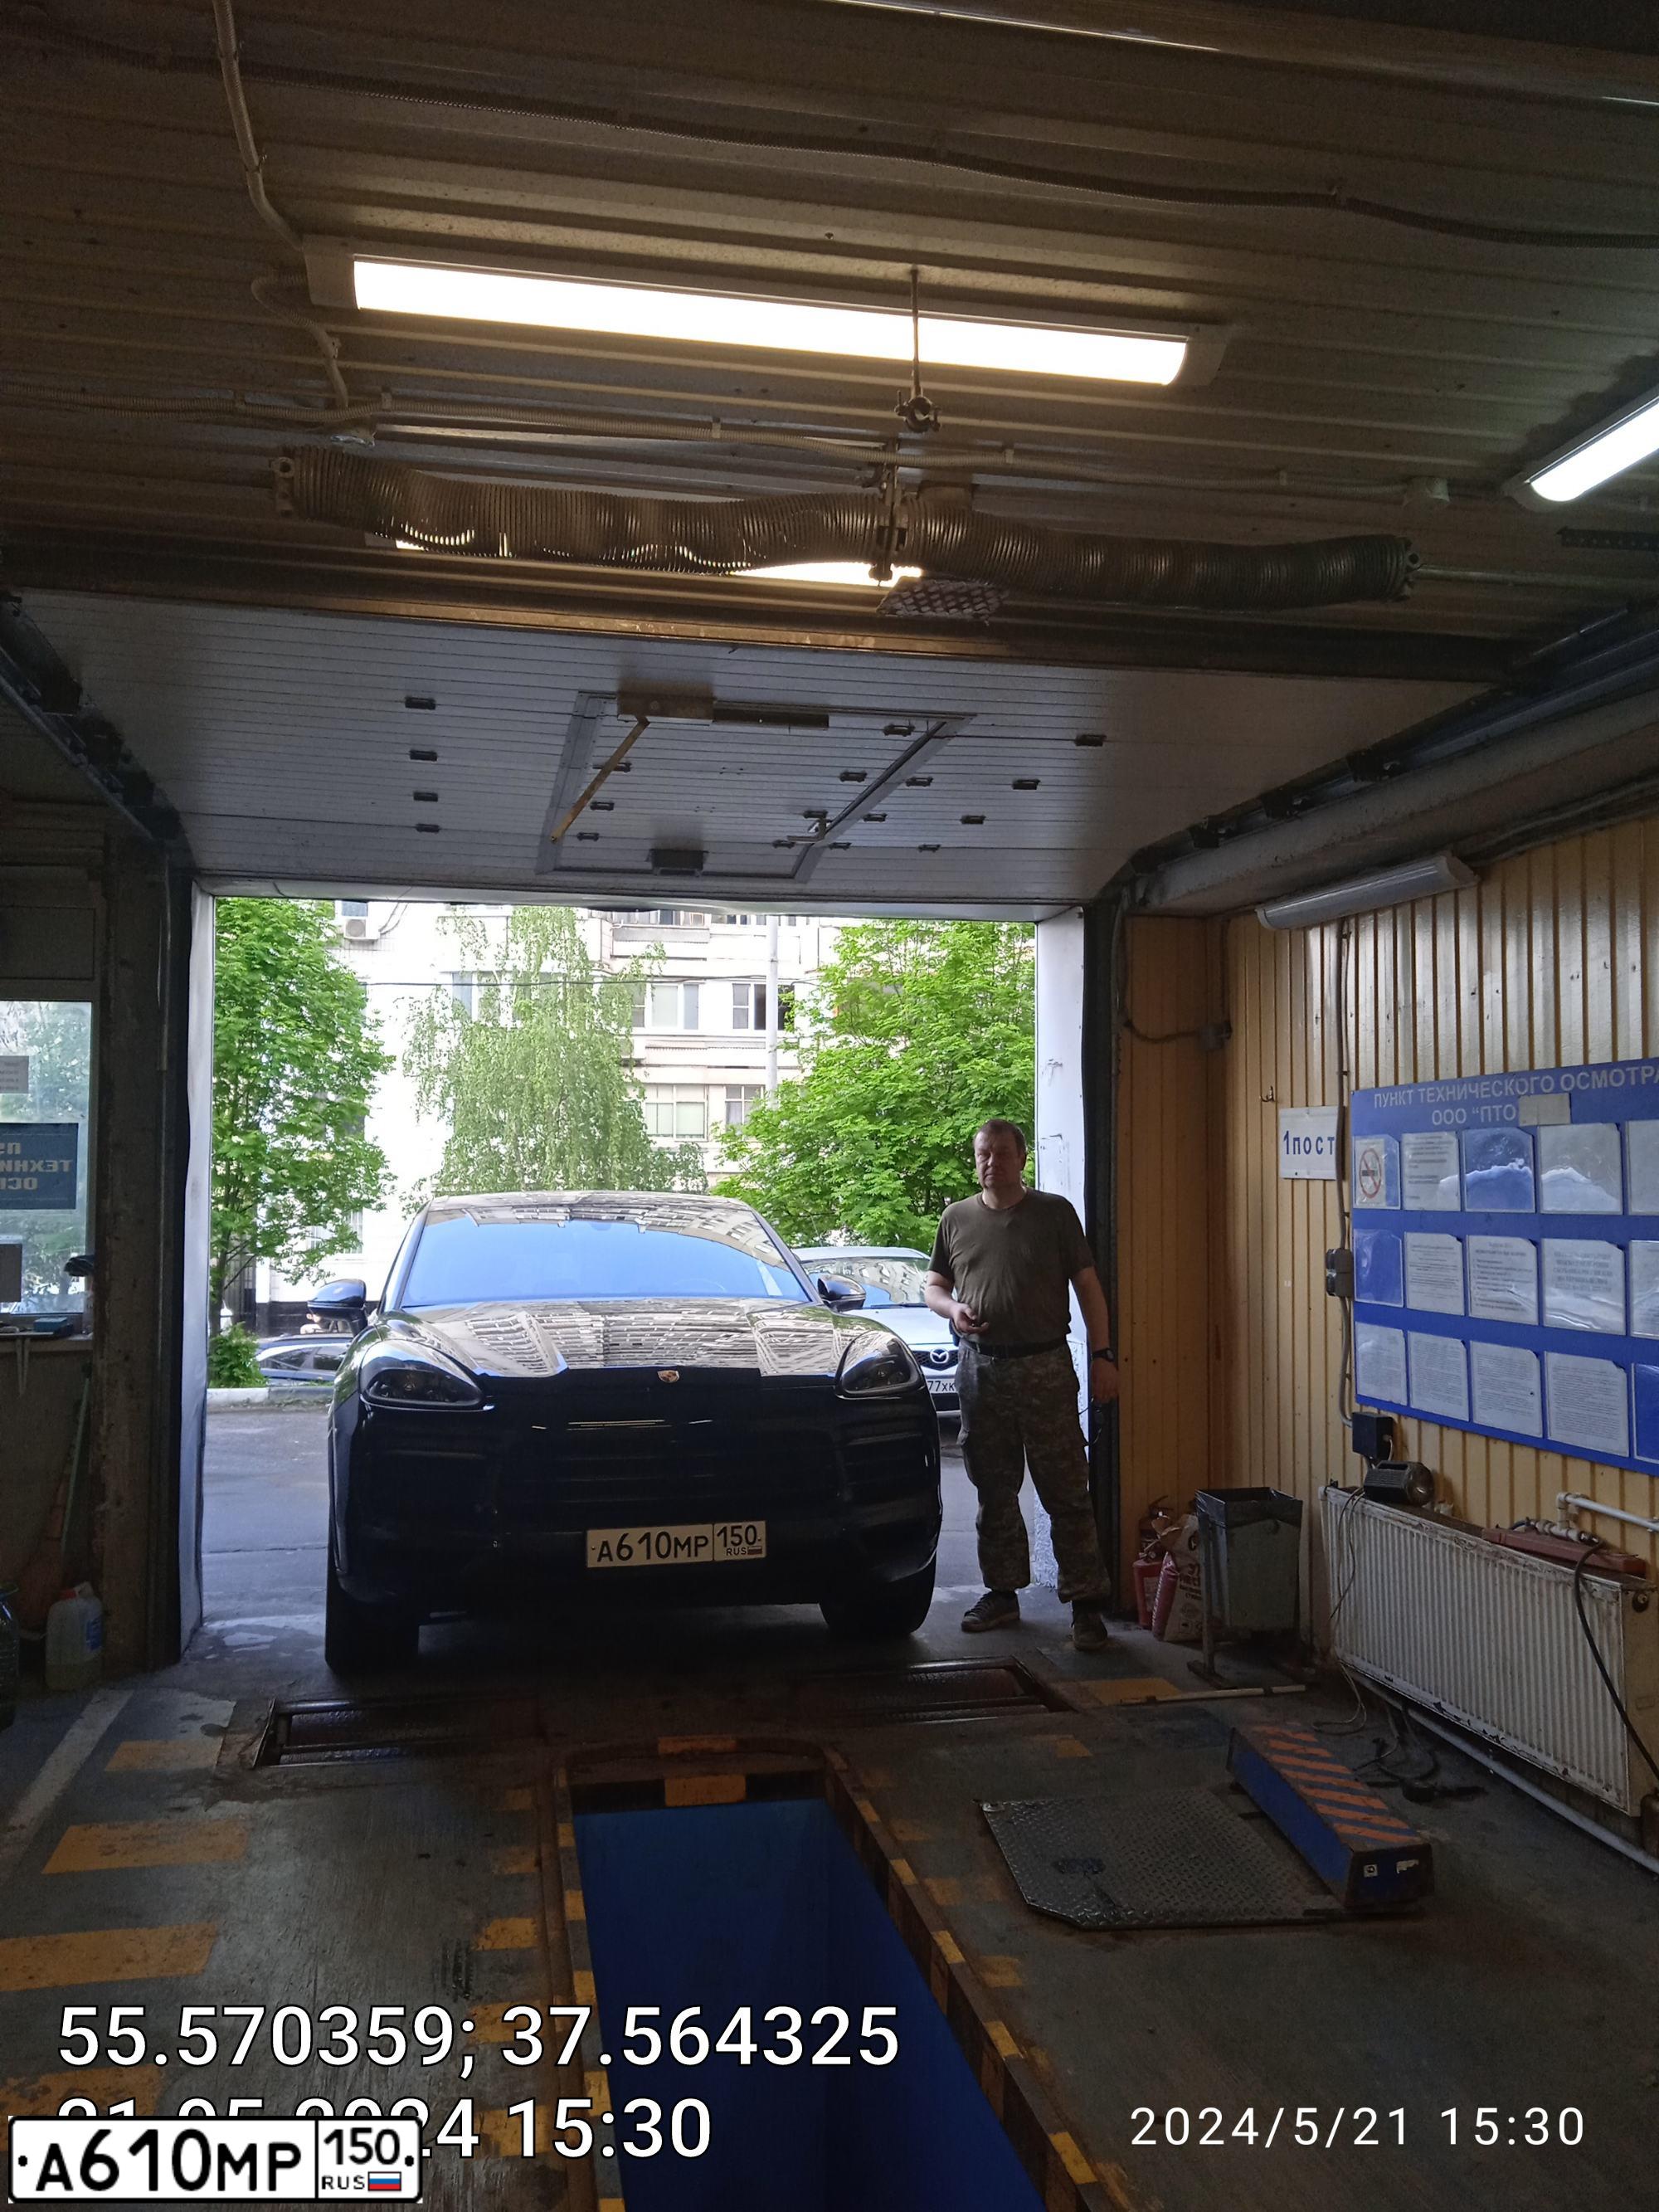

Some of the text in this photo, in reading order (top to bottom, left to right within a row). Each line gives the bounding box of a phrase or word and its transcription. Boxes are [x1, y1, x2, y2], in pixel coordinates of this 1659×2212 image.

[1374, 1090, 1412, 1108] ПУНКТ
[1418, 1075, 1554, 1104] ТЕХНИЧЕСКОГО
[1432, 1108, 1467, 1126] ООО
[597, 1525, 757, 1562] А610МР 150
[726, 1547, 747, 1556] RUS
